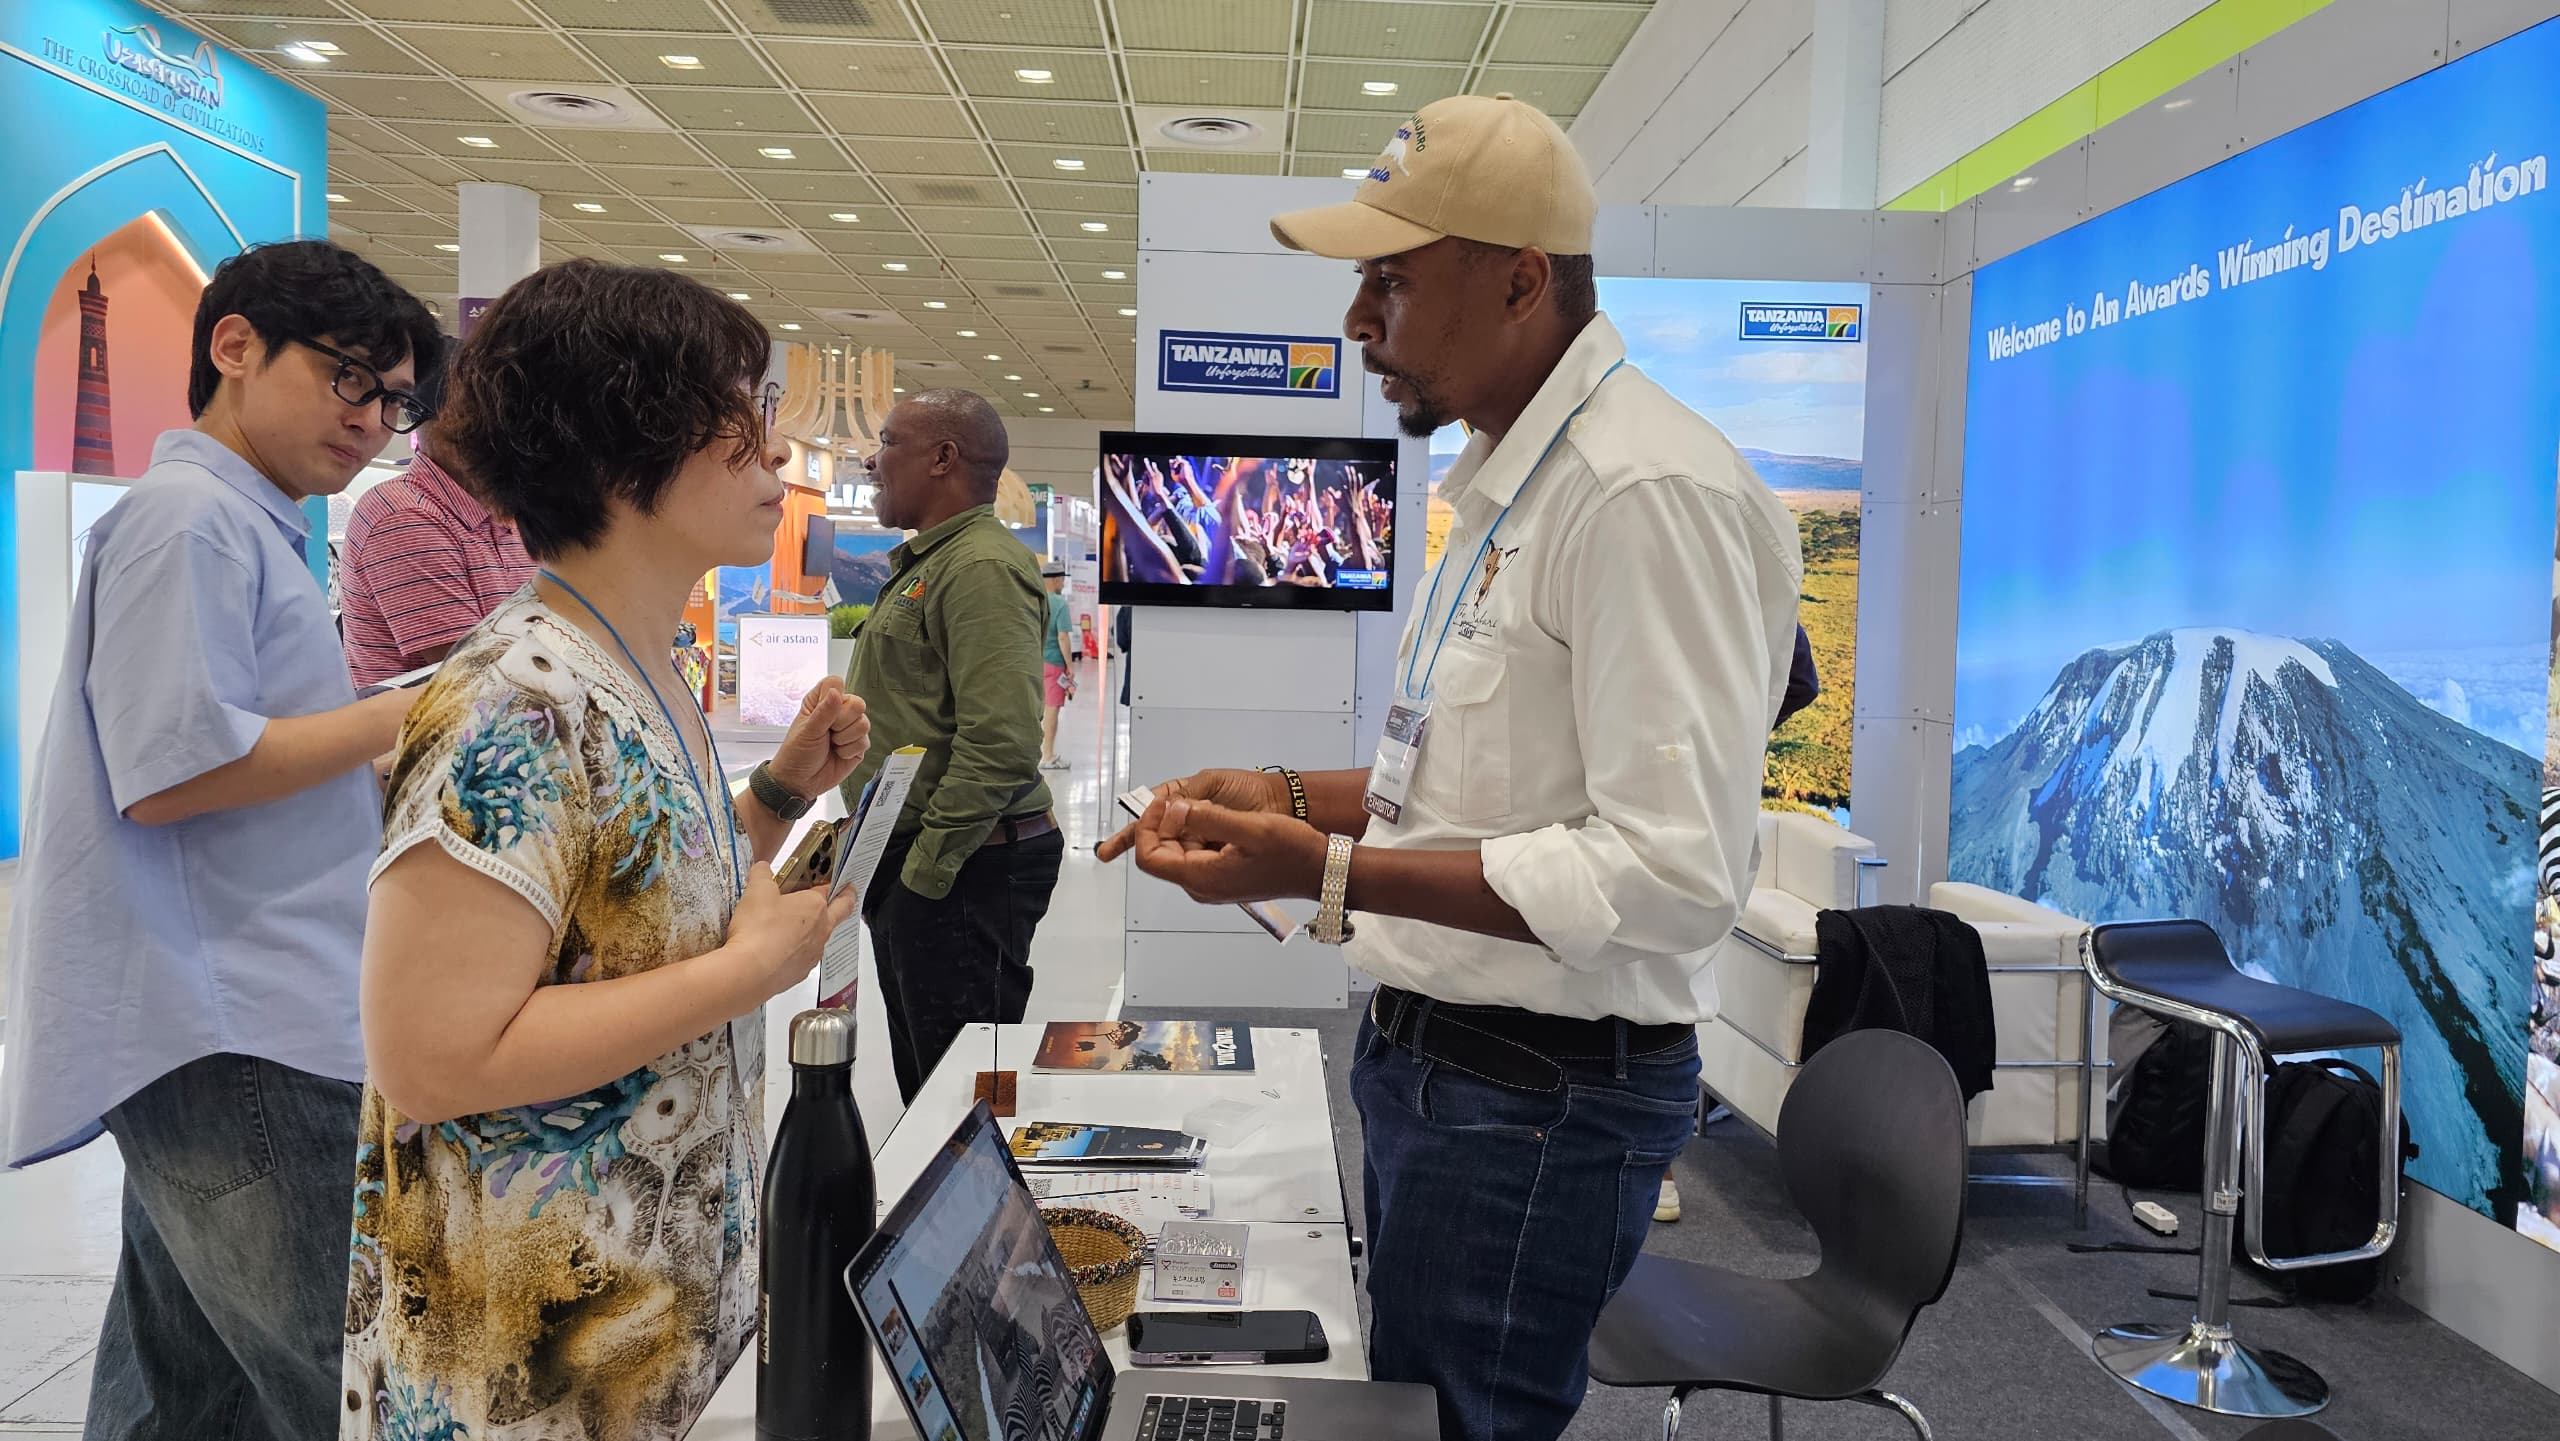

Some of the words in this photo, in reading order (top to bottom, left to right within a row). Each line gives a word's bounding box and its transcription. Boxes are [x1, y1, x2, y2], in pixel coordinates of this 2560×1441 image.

[43, 37, 74, 67] THE
[78, 55, 160, 104] CROSSROAD
[181, 102, 265, 152] CIVILIZATIONS
[1988, 321, 2061, 361] Welcome
[2066, 303, 2086, 337] to
[2090, 292, 2120, 330] An
[2124, 263, 2210, 320] Awards
[2217, 224, 2330, 290] Winning
[2337, 150, 2547, 253] Destination
[1747, 309, 1825, 324] TANZANIA
[1769, 322, 1825, 334] Unforgettable!
[1171, 344, 1285, 366] TANZANIA
[1205, 365, 1284, 380] Unforgettable!
[766, 633, 780, 644] air
[783, 634, 819, 644] astana
[1368, 795, 1397, 820] EXHIBITOR
